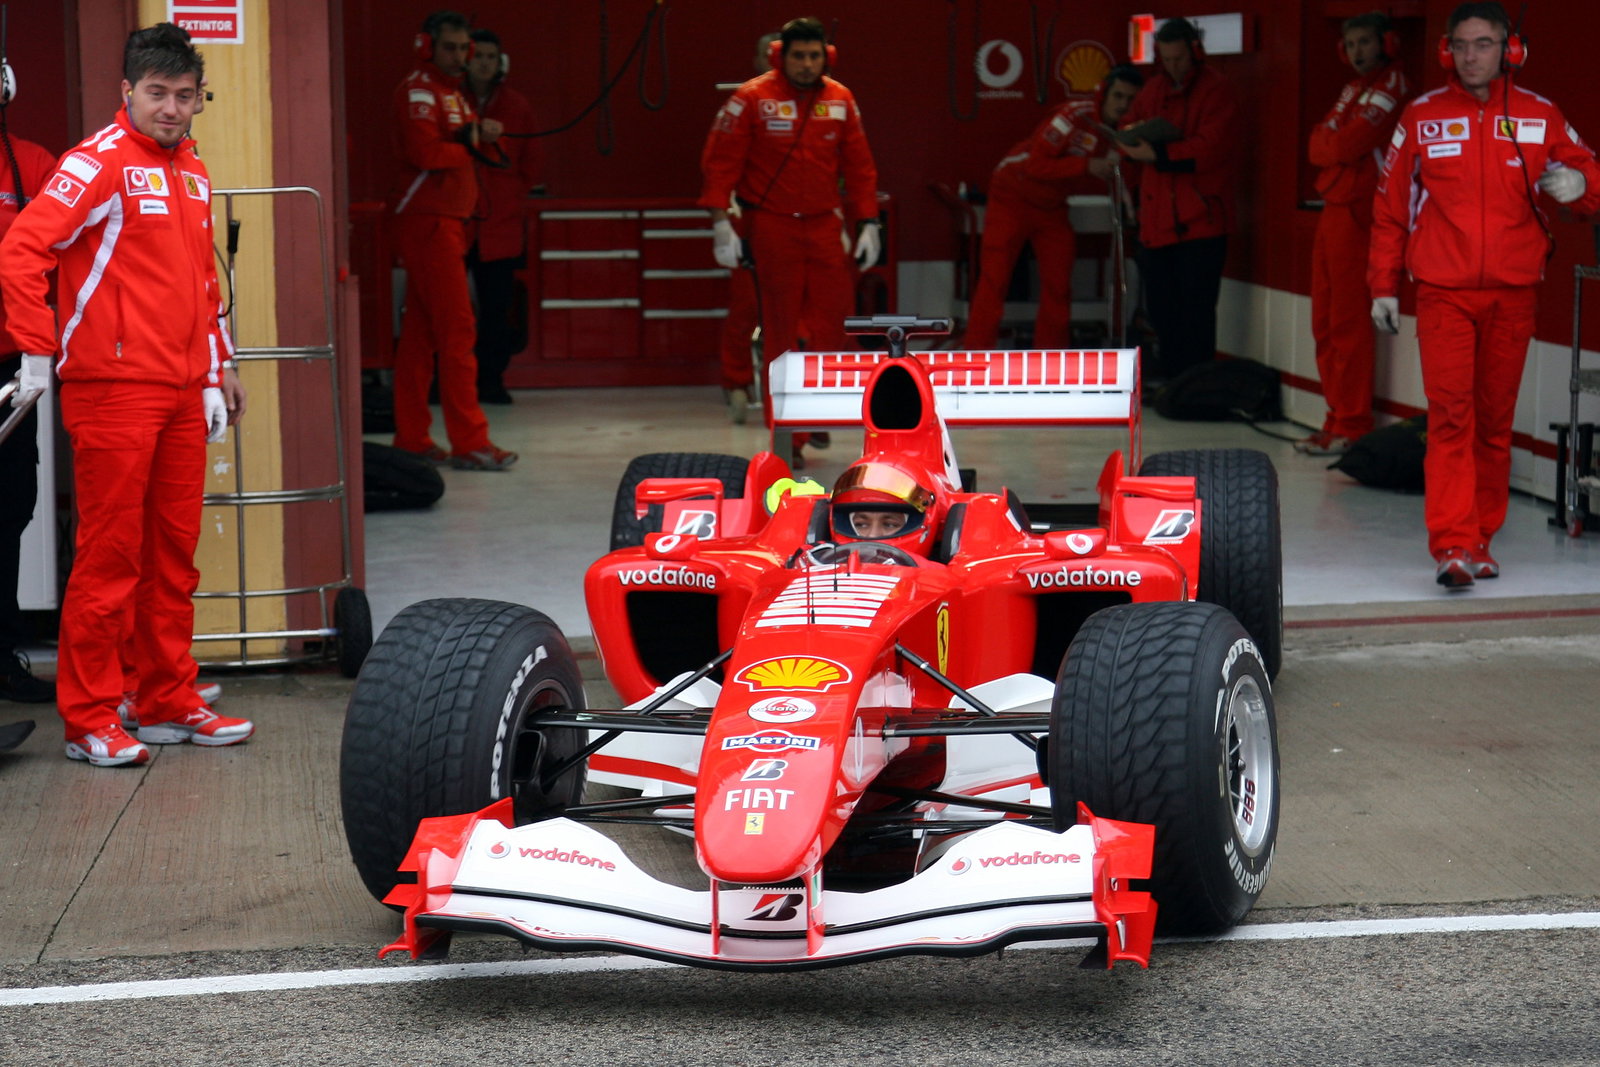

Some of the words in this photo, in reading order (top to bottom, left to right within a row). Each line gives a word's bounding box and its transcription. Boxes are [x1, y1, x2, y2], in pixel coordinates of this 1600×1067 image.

[178, 20, 232, 31] EXTINTOR
[618, 564, 716, 589] vodafone
[1026, 565, 1141, 588] vodafone
[729, 737, 813, 747] MARTINI
[724, 788, 795, 811] FIAT
[1241, 778, 1256, 826] BBS
[518, 847, 617, 872] vodafone
[978, 850, 1081, 868] vodafone
